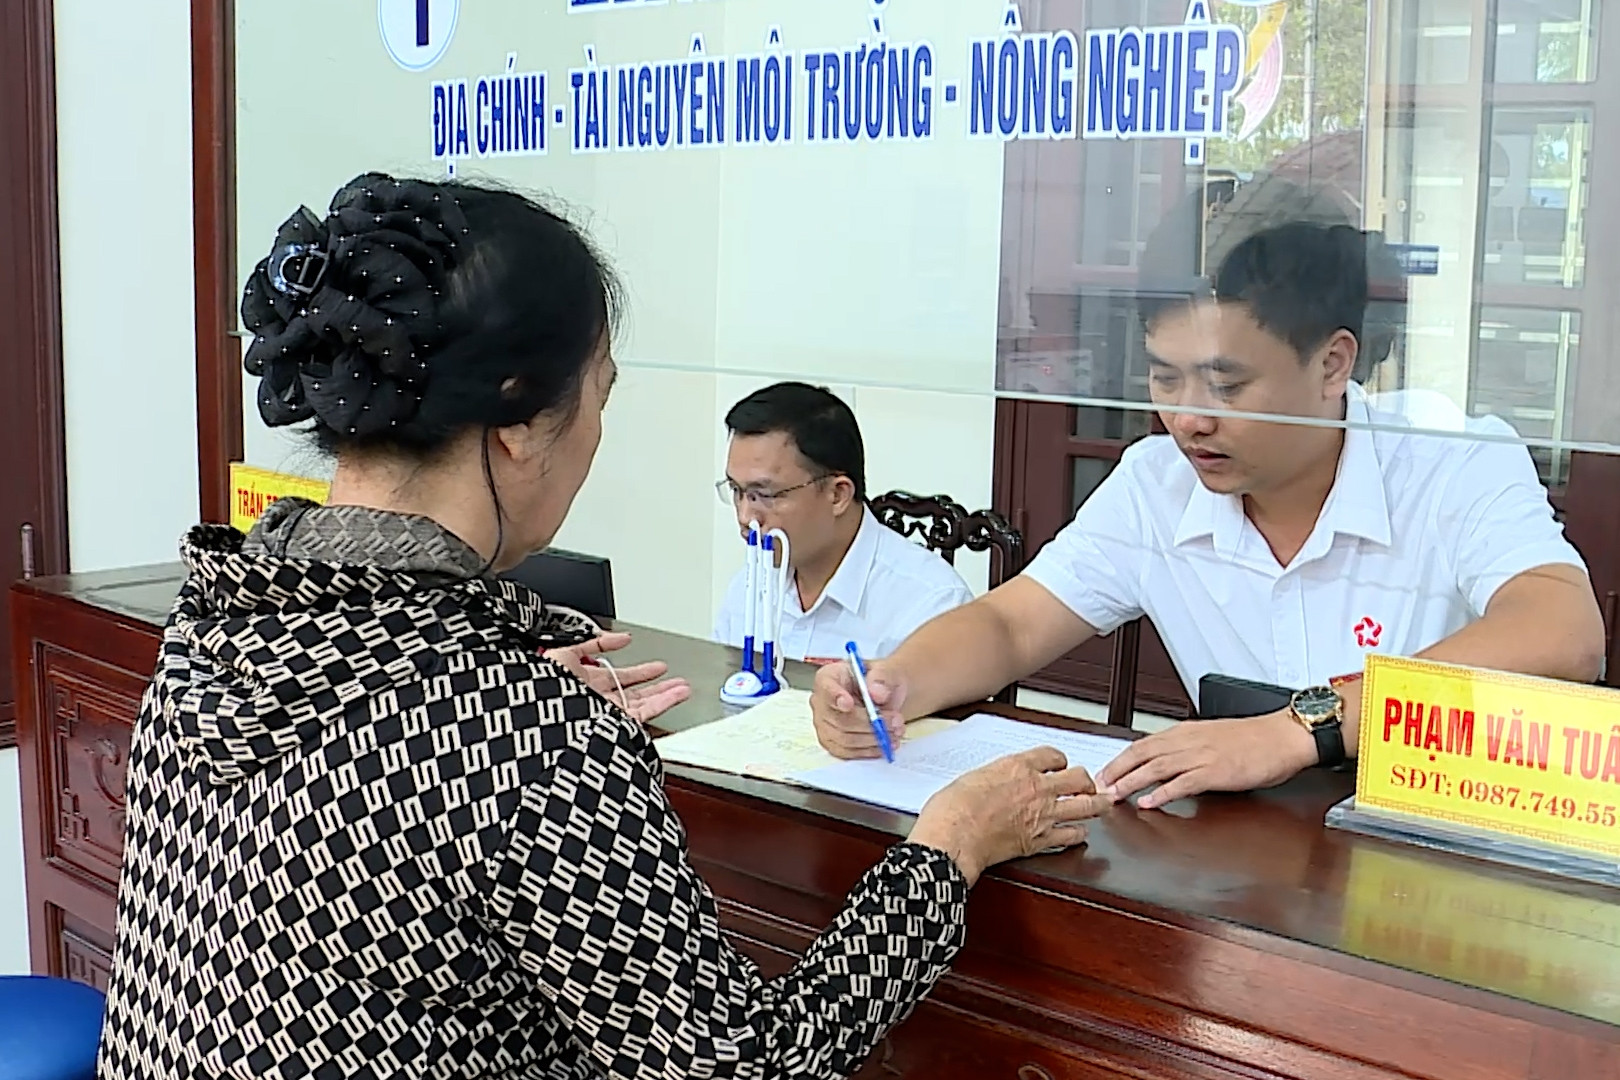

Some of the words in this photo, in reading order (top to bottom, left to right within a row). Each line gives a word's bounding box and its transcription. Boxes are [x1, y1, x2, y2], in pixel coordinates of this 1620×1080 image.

[433, 84, 470, 174] ĐỊA
[476, 57, 546, 154] CHÍNH
[571, 48, 609, 150] TÀI
[618, 36, 725, 148] NGUYÊN
[736, 28, 793, 142] MÔI
[805, 17, 932, 141] TRƯỜNG
[970, 9, 1073, 135] NÔNG
[1087, 3, 1242, 159] NGHIỆP
[1383, 697, 1475, 762] PHẠM
[1486, 708, 1551, 772] VĂN
[1390, 763, 1452, 797] SĐT:
